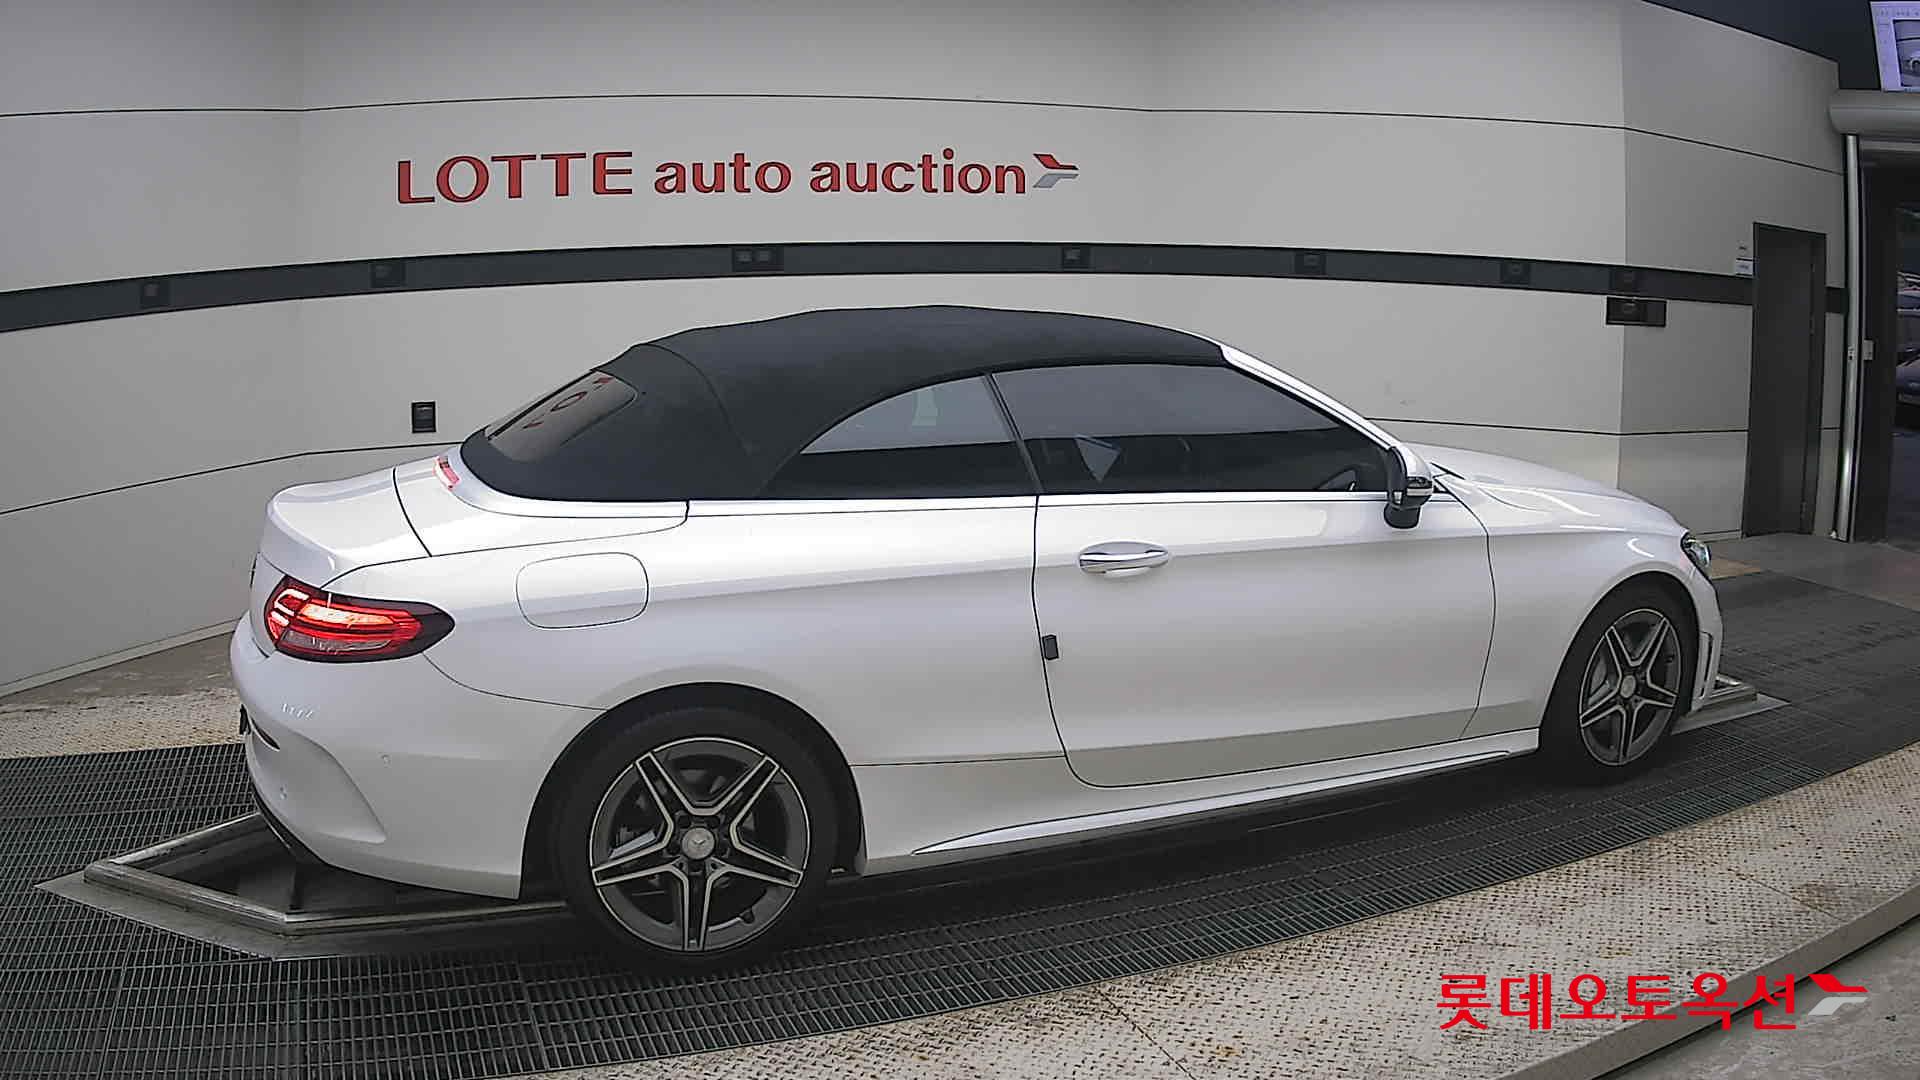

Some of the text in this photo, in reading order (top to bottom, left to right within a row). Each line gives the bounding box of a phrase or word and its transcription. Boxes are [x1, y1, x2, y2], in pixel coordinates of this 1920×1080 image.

[398, 149, 1026, 204] LOTTE auto auction
